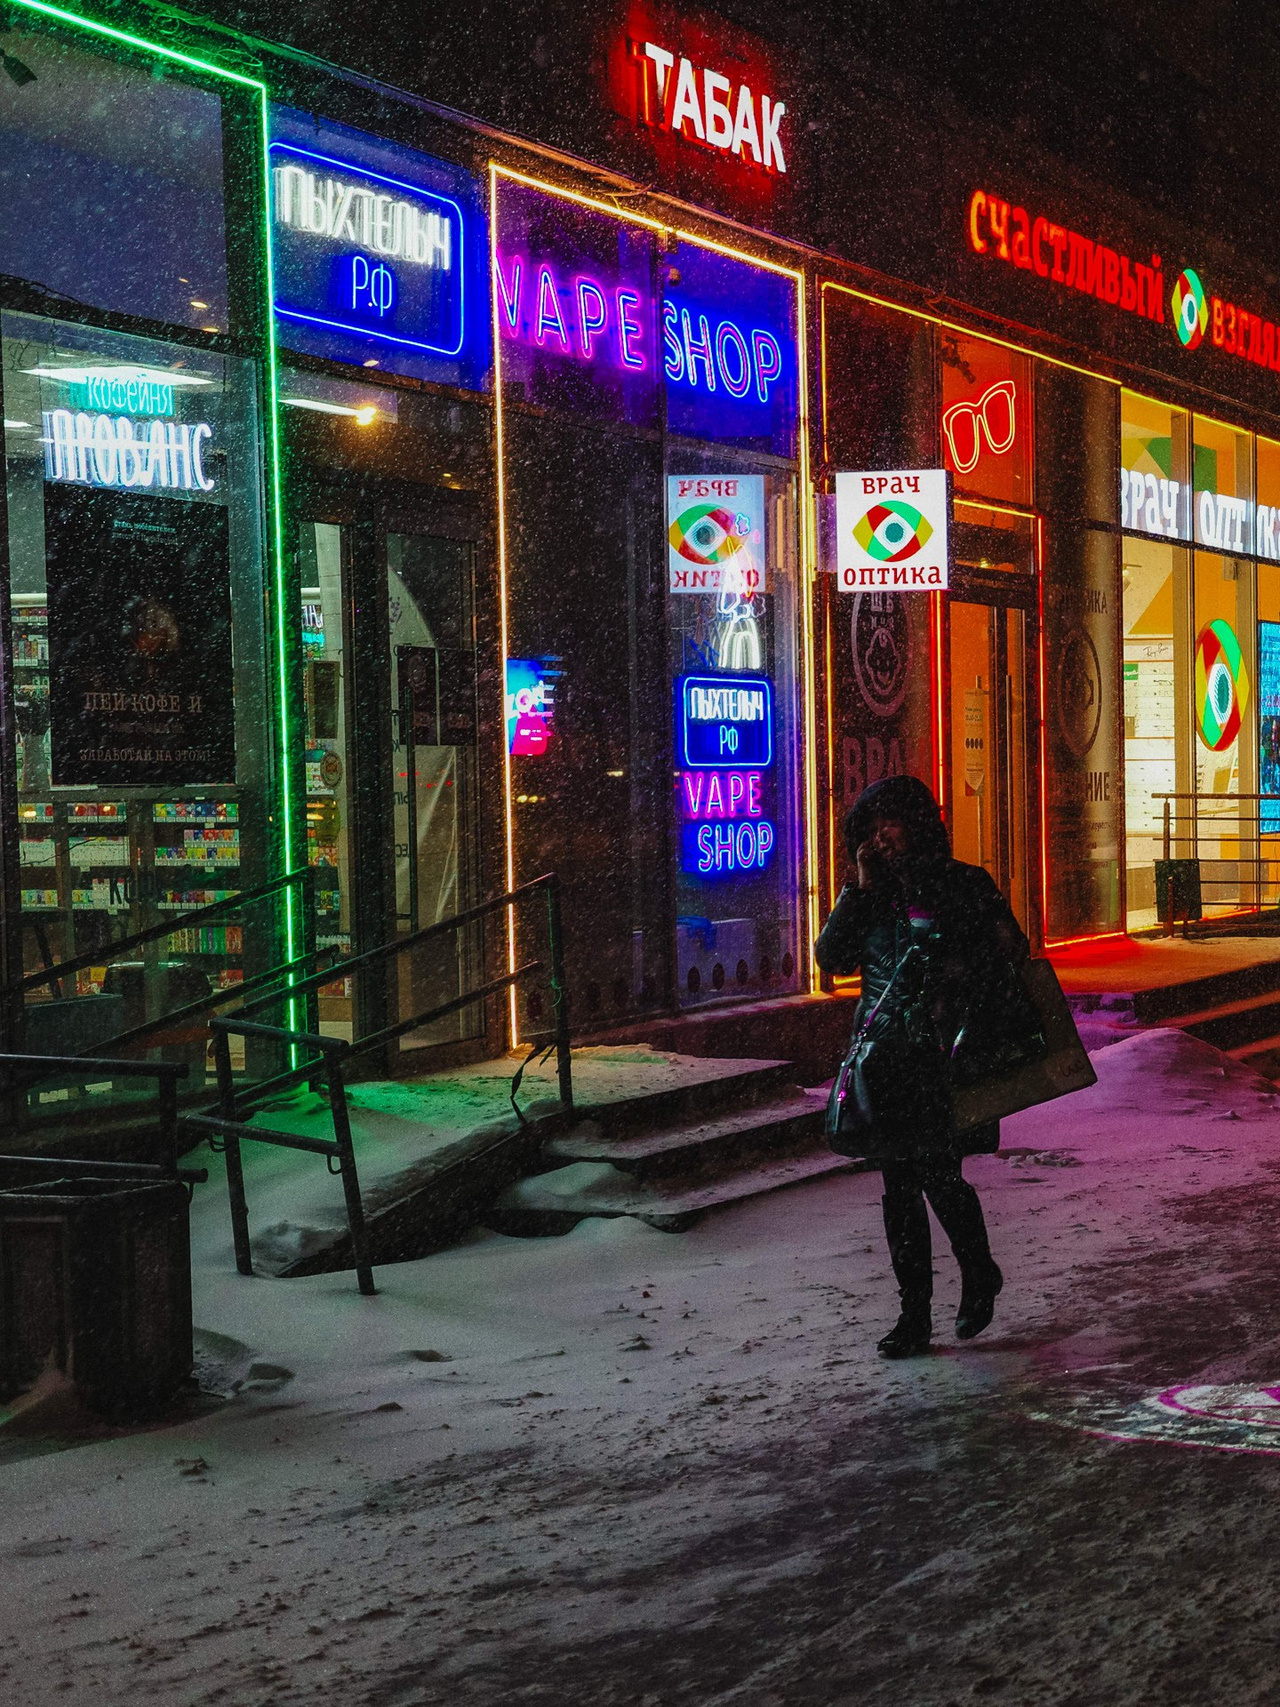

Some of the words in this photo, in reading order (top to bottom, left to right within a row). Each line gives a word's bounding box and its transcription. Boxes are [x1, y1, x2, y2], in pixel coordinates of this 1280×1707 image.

[645, 41, 786, 172] ТАБАК
[352, 256, 392, 317] РФ
[496, 254, 646, 371] VAPE
[664, 299, 782, 402] SHOP
[84, 688, 126, 712] ПЕЙ
[131, 693, 180, 713] КОФЕ
[189, 696, 203, 713] И
[719, 725, 739, 754] РФ
[684, 771, 762, 819] VAPE
[698, 822, 773, 872] SHOP
